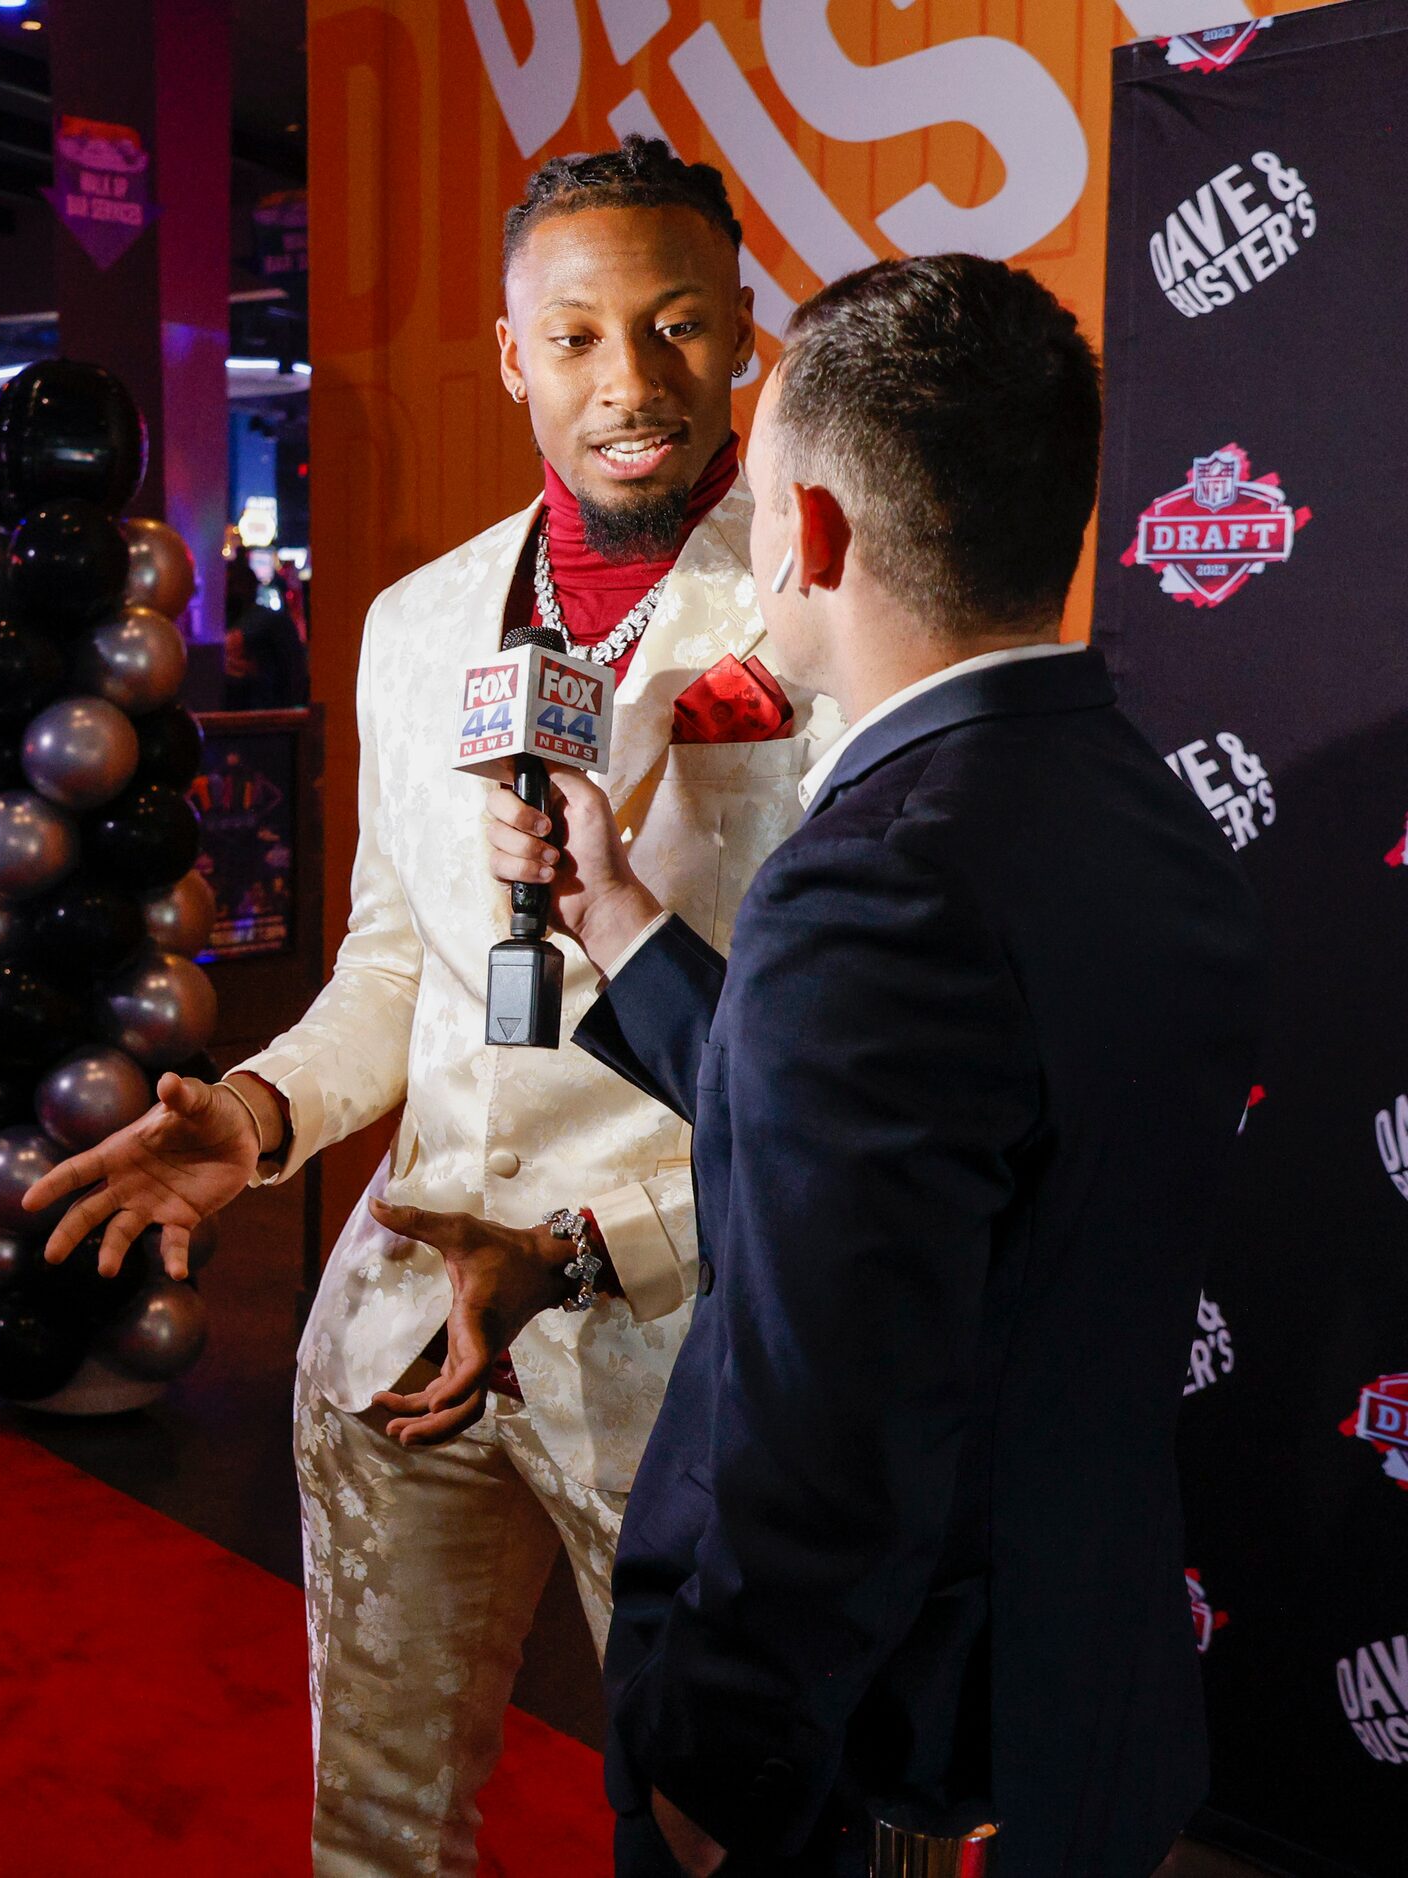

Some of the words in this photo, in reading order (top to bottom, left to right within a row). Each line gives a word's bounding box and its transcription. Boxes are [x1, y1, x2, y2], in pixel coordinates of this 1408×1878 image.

[1149, 164, 1272, 291] DAVE
[1251, 151, 1307, 202] &
[1165, 191, 1316, 318] BUSTER'S
[1152, 523, 1278, 551] DRAFT
[1195, 564, 1229, 577] 2023
[466, 668, 514, 710] FOX
[543, 668, 598, 712] FOX
[461, 703, 512, 738] 44
[537, 705, 597, 745] 44
[463, 735, 511, 756] NEWS
[539, 735, 593, 759] NEWS
[1215, 731, 1268, 787] &
[1336, 1634, 1408, 1721] DAV
